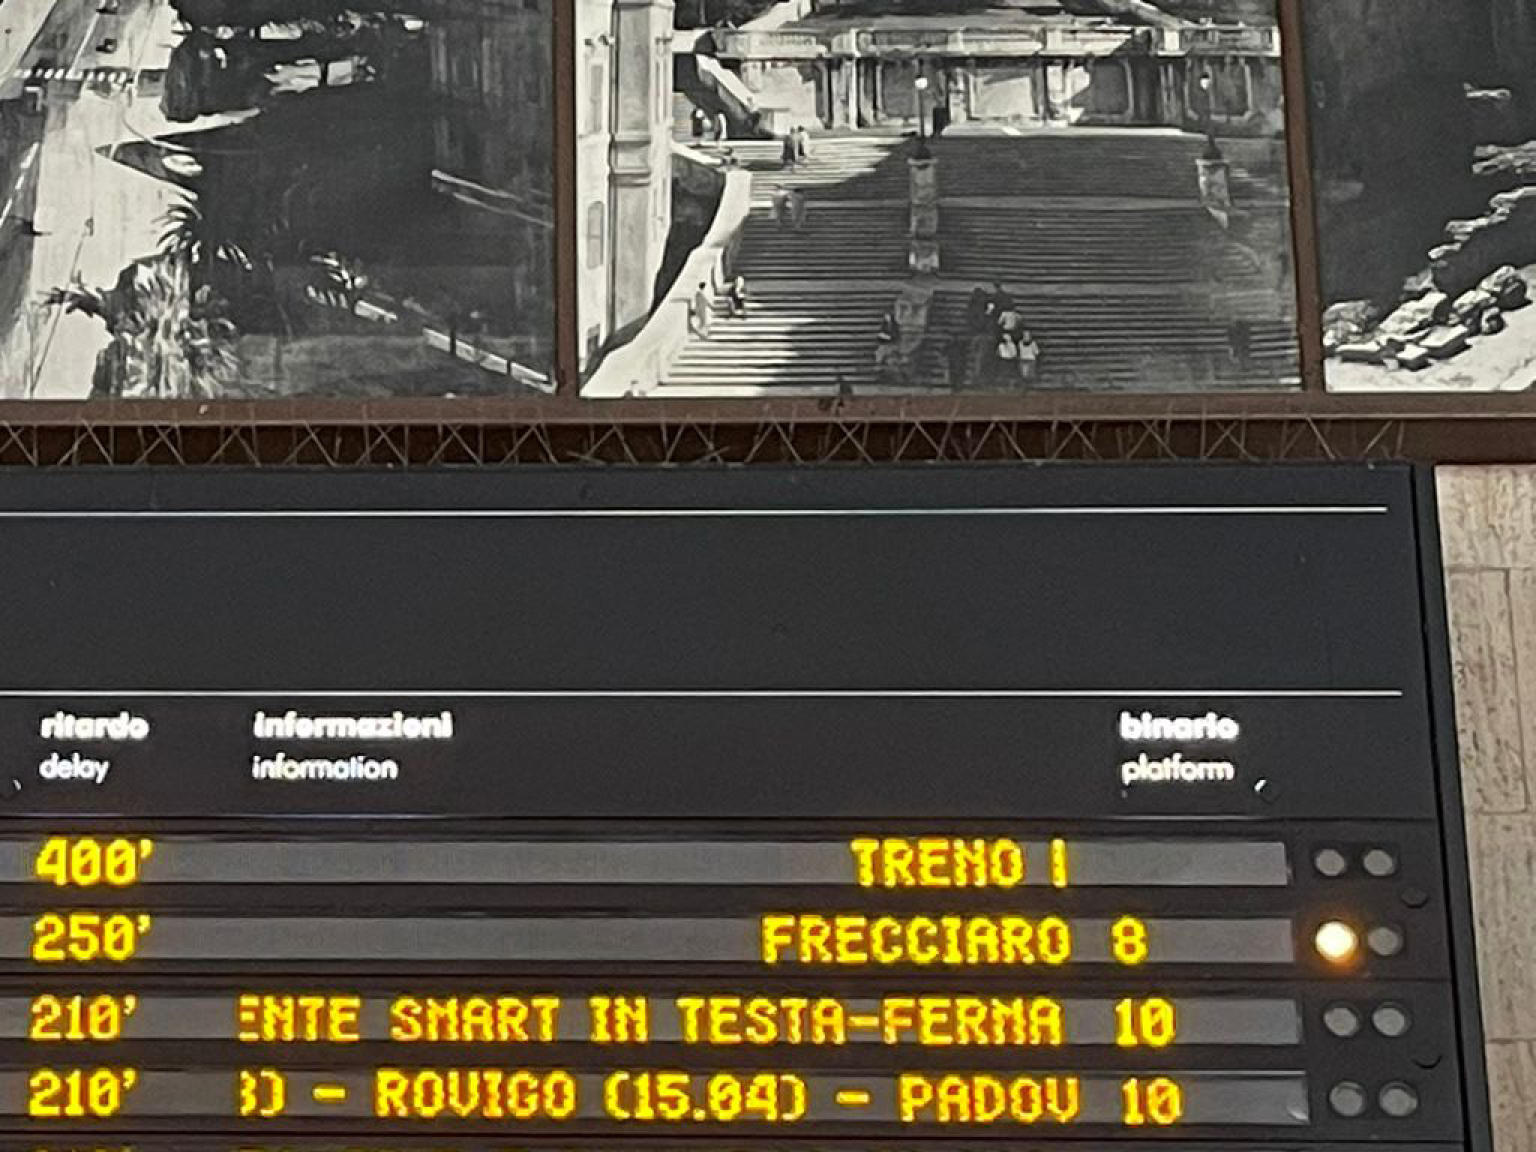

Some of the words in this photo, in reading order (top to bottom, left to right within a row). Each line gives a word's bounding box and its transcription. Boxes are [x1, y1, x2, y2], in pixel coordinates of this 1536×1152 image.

[40, 710, 150, 740] ritardo
[253, 710, 454, 739] informazioni
[1119, 711, 1240, 741] binario
[38, 752, 109, 784] delay
[251, 752, 399, 781] information
[1121, 752, 1235, 786] platform
[851, 838, 1024, 887] TRENO
[762, 914, 1071, 964] FRECCIARO
[1112, 917, 1147, 964] 8
[391, 998, 560, 1042] SMART
[590, 997, 649, 1042] IN
[677, 998, 1062, 1045] TESTA-FERMA
[1115, 998, 1176, 1047] 10
[377, 1070, 576, 1118] ROVIGO
[605, 1072, 806, 1121] (15.04)
[900, 1076, 1080, 1123] PADOV
[1122, 1078, 1182, 1125] 10
